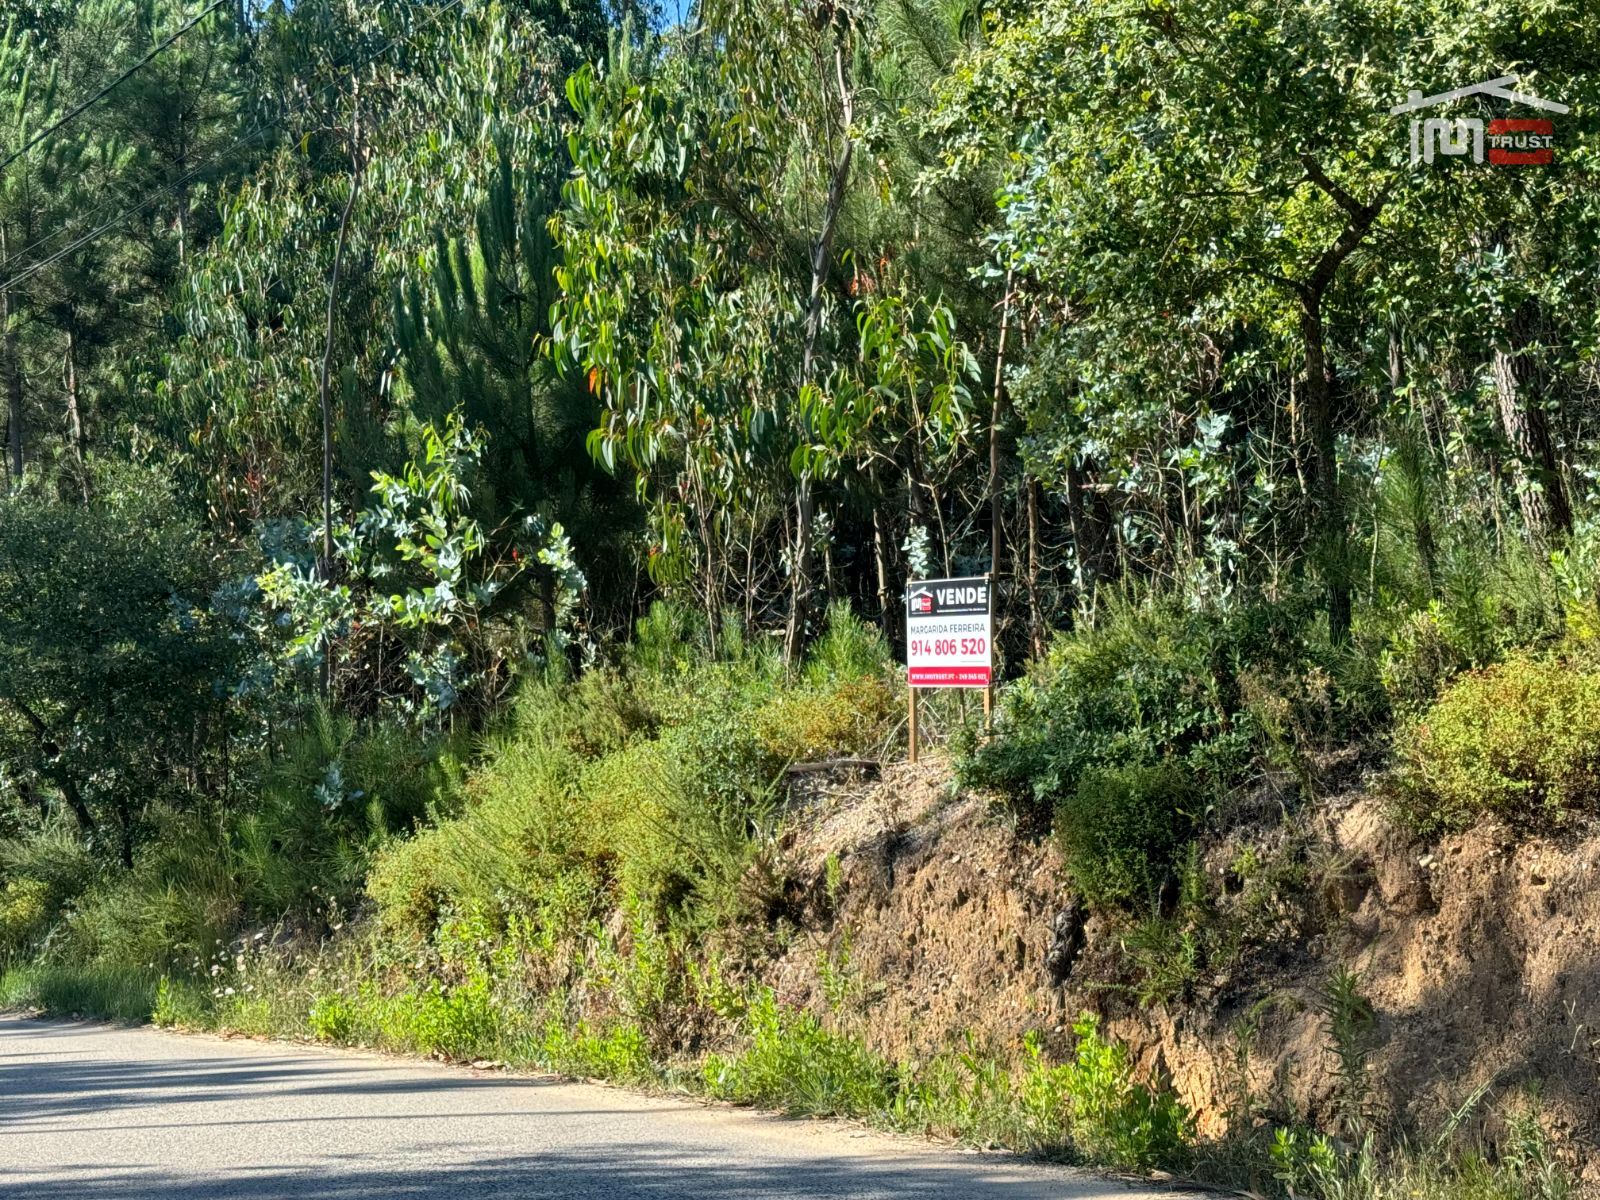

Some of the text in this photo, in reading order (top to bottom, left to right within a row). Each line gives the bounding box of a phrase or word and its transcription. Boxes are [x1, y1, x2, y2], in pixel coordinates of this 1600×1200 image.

[936, 587, 987, 606] VENDE
[911, 623, 985, 634] MARGARIDA FERREIRA
[911, 638, 986, 656] 914 806 520
